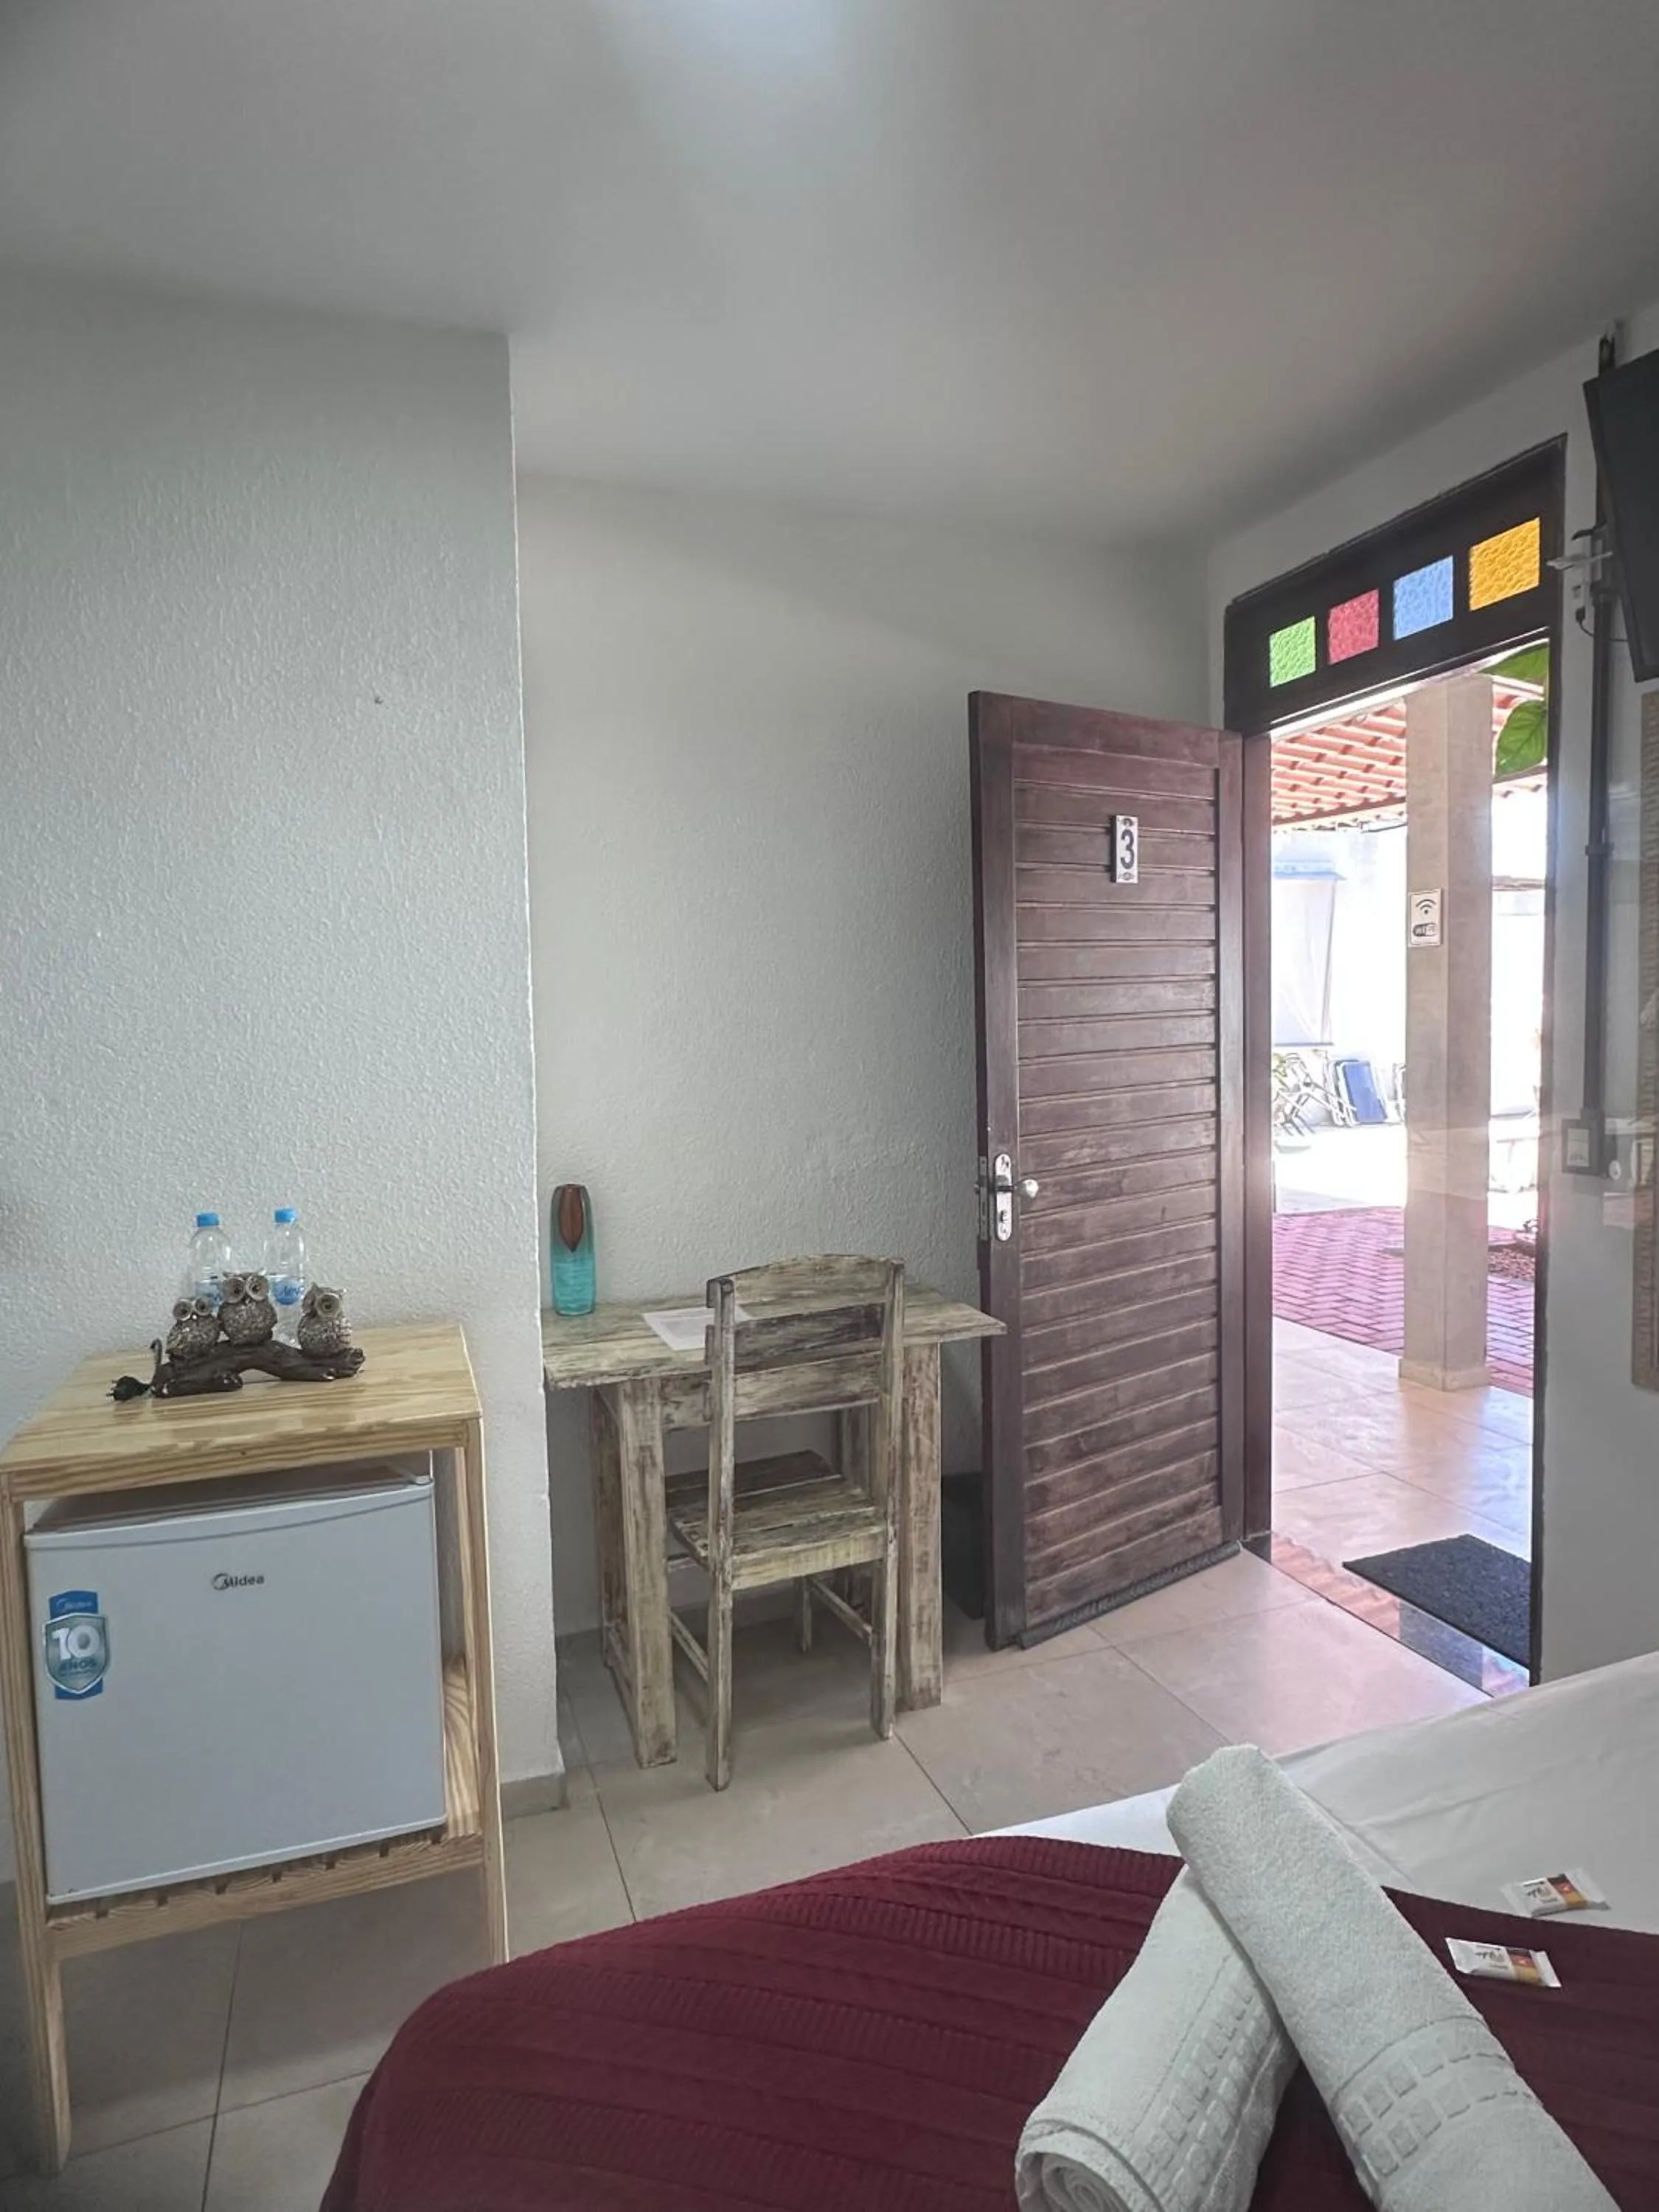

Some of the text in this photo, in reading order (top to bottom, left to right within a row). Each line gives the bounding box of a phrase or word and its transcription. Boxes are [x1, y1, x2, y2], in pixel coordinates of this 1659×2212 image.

[1120, 829, 1135, 869] 3
[213, 1573, 265, 1590] Midea
[51, 1624, 100, 1660] 10
